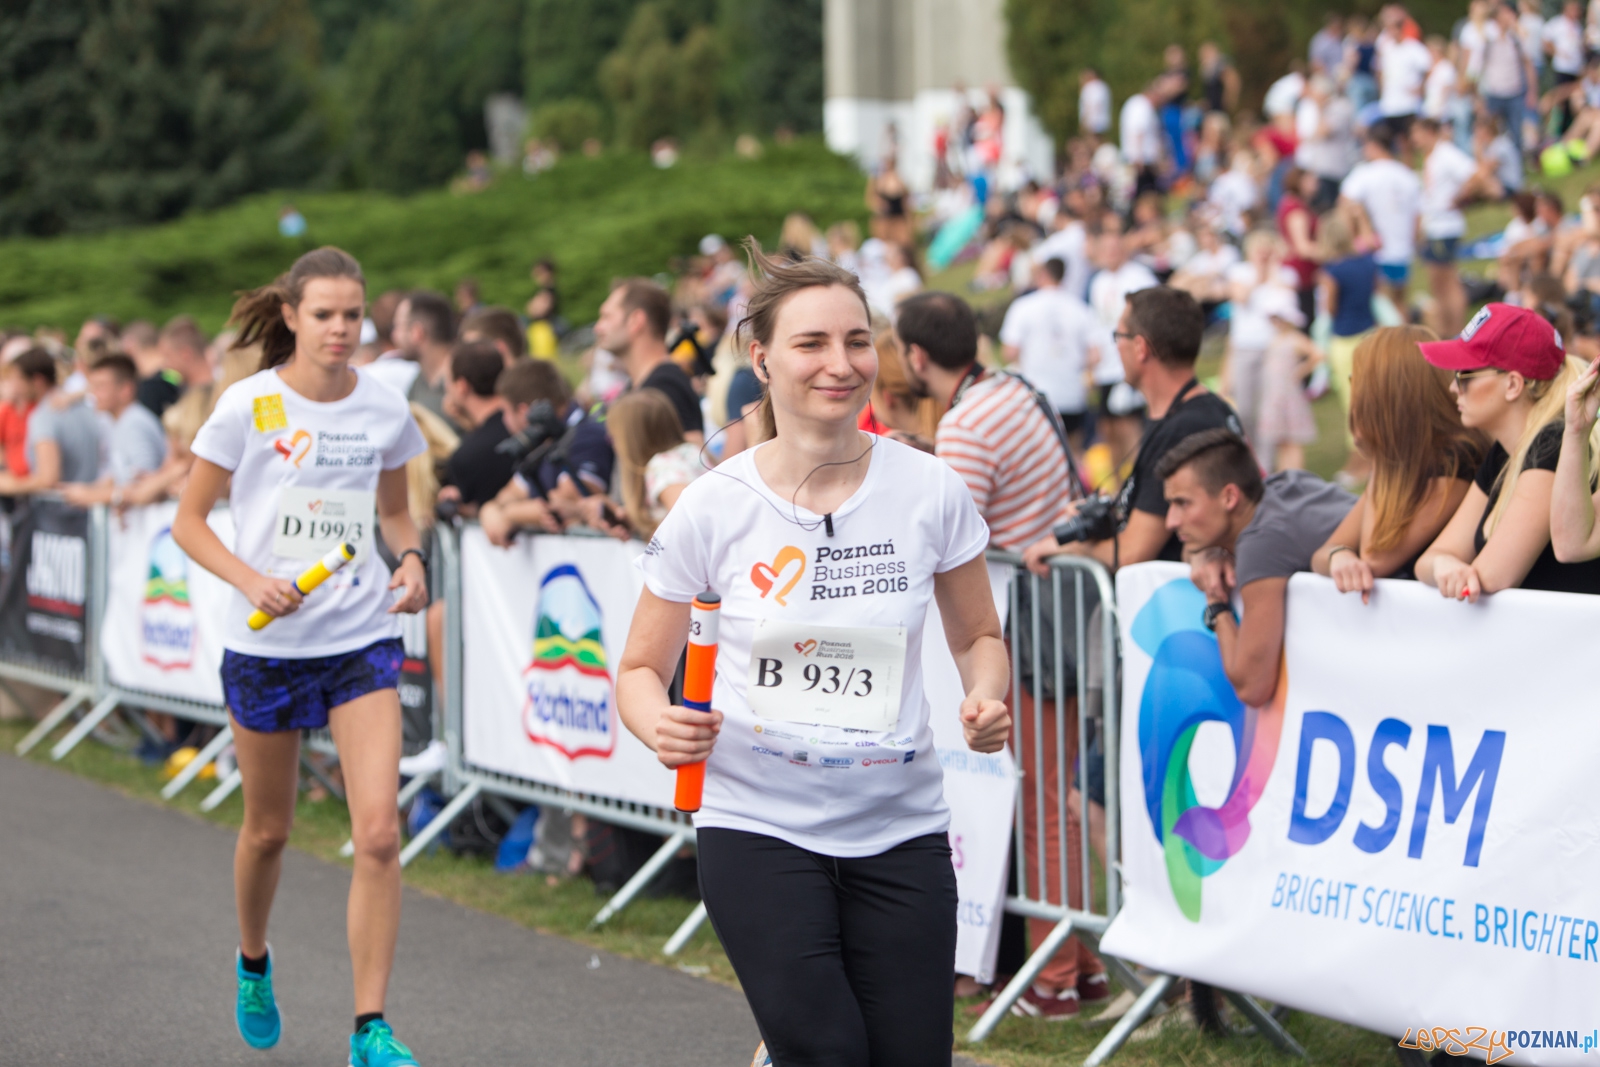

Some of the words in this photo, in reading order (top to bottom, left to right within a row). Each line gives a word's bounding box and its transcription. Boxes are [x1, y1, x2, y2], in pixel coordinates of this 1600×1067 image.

[315, 456, 343, 467] Run
[283, 515, 302, 537] D
[308, 519, 364, 543] 199/3
[815, 538, 896, 564] Poznań
[812, 560, 907, 583] Business
[810, 584, 858, 601] Run
[862, 576, 909, 596] 2016
[815, 651, 834, 659] Run
[753, 657, 783, 688] B
[801, 663, 873, 697] 93/3
[1287, 711, 1506, 867] DSM
[1271, 872, 1357, 920] BRIGHT
[1359, 886, 1464, 940] SCIENCE.
[1474, 902, 1600, 963] BRIGHTER
